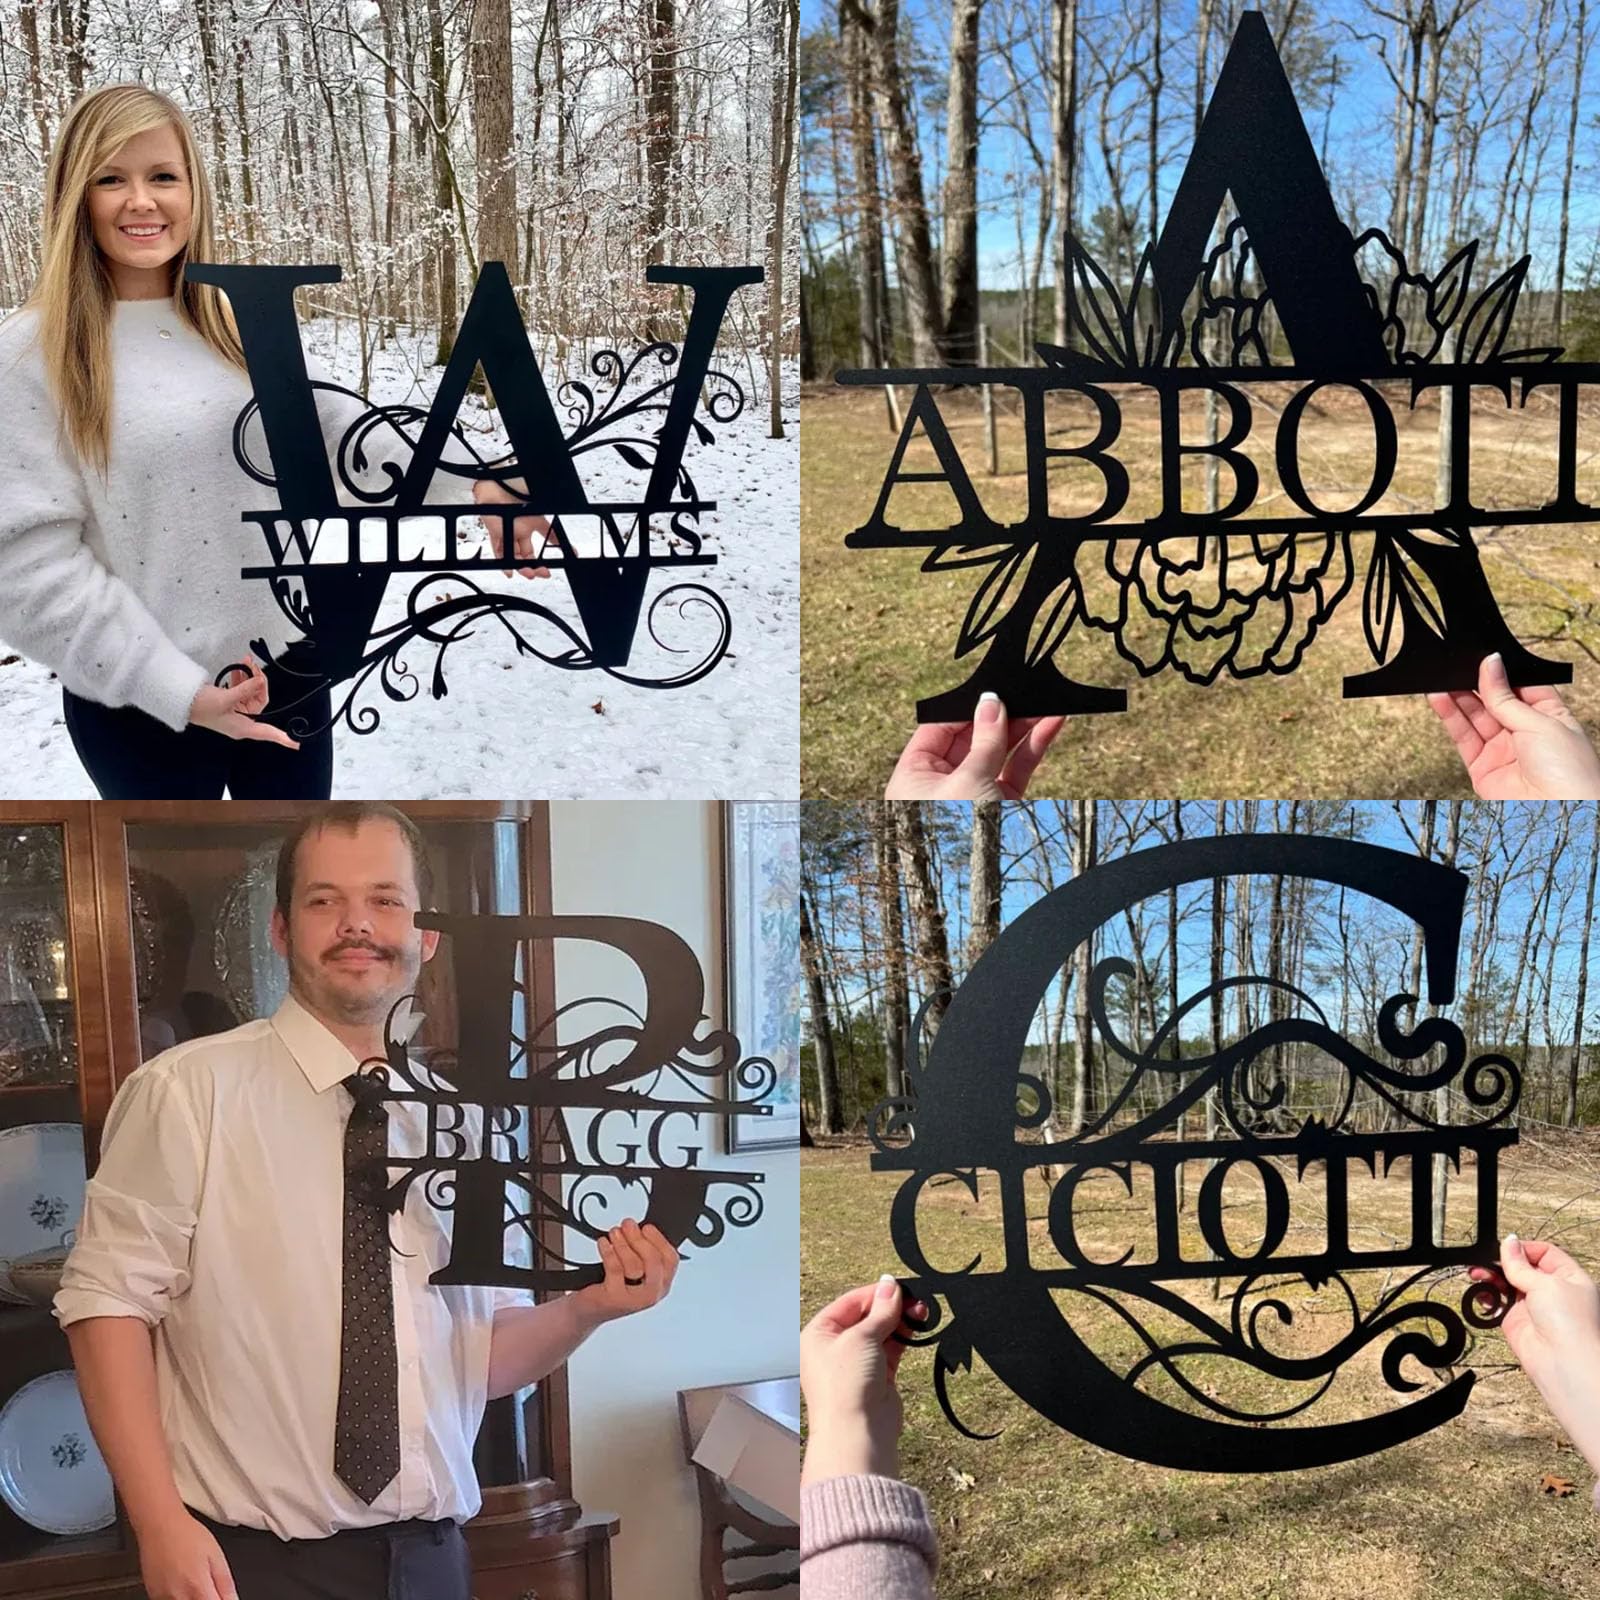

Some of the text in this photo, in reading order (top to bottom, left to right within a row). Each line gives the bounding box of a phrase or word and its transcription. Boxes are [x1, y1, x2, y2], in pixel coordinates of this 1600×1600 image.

[185, 261, 764, 677] W
[855, 372, 1600, 535] ABBOTT
[916, 10, 1573, 724] A
[256, 509, 703, 566] WILLIAMS
[414, 912, 708, 1291] B
[421, 1100, 704, 1171] BRAGG
[888, 1140, 1502, 1279] CICIOTTI
[912, 833, 1475, 1474] C
